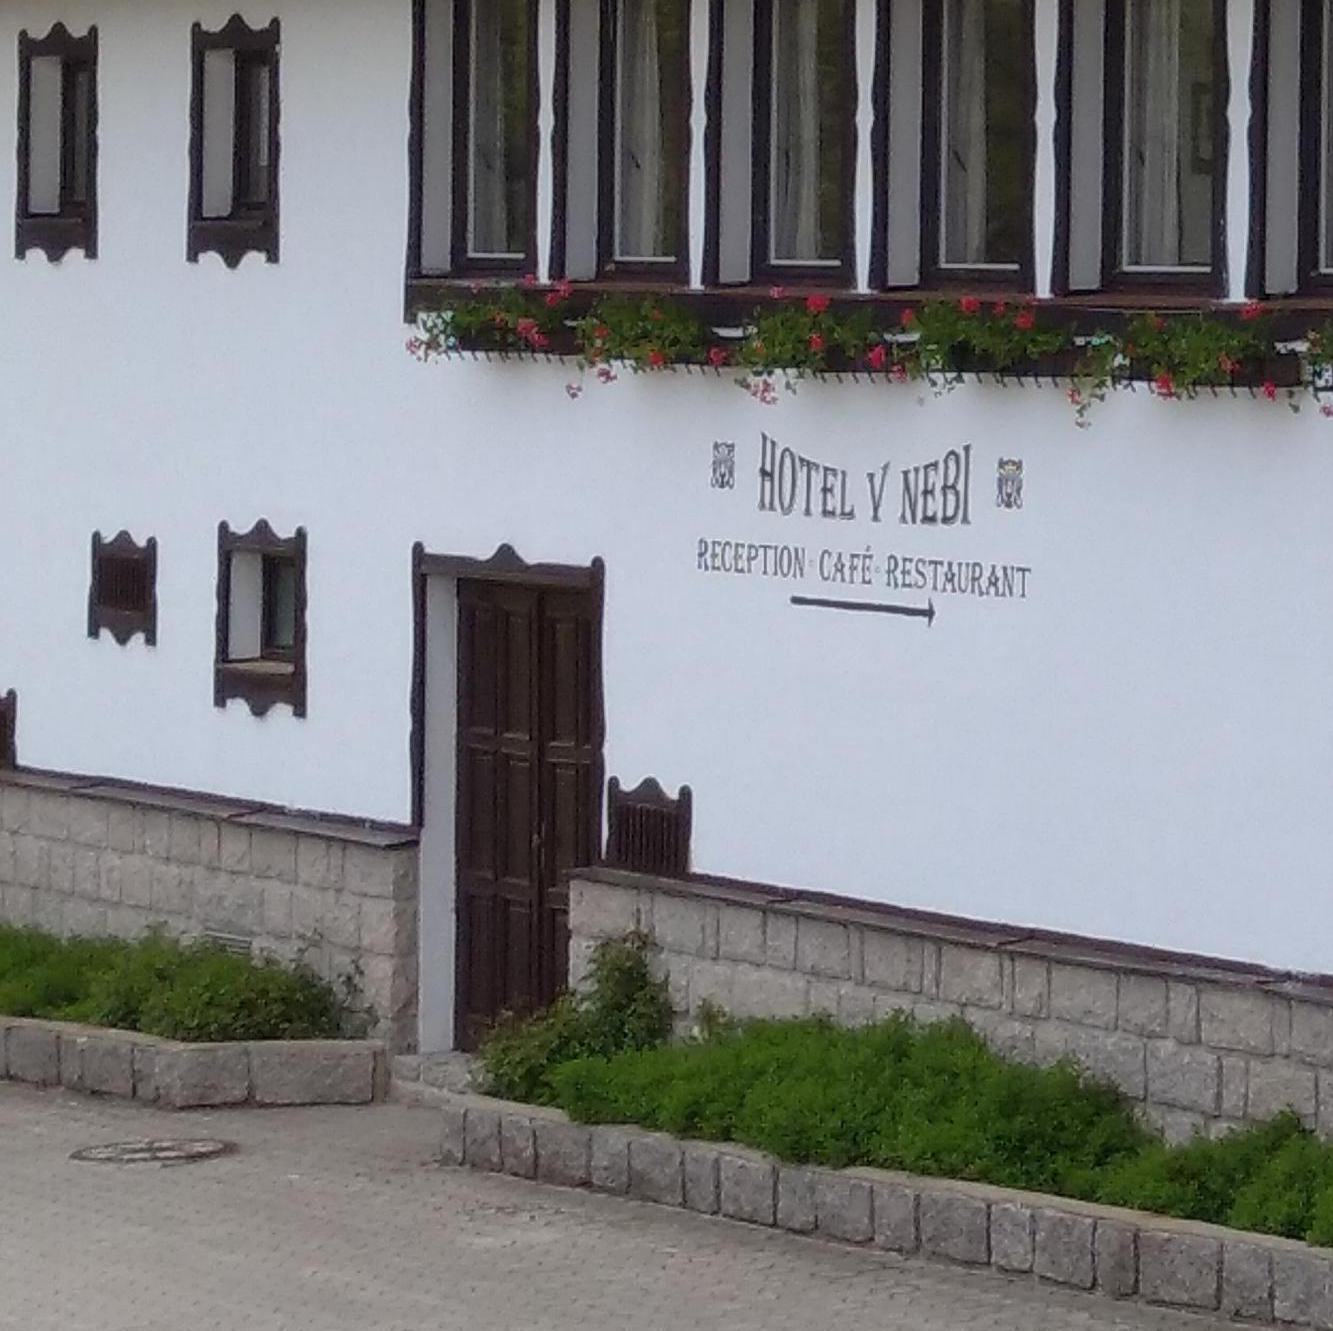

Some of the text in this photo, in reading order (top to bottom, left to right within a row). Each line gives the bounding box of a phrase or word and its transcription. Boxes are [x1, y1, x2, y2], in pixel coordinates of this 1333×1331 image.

[757, 431, 973, 526] HOTEL V NEBI
[696, 537, 1032, 599] RECEPTION CAFÉ RESTAURANT
